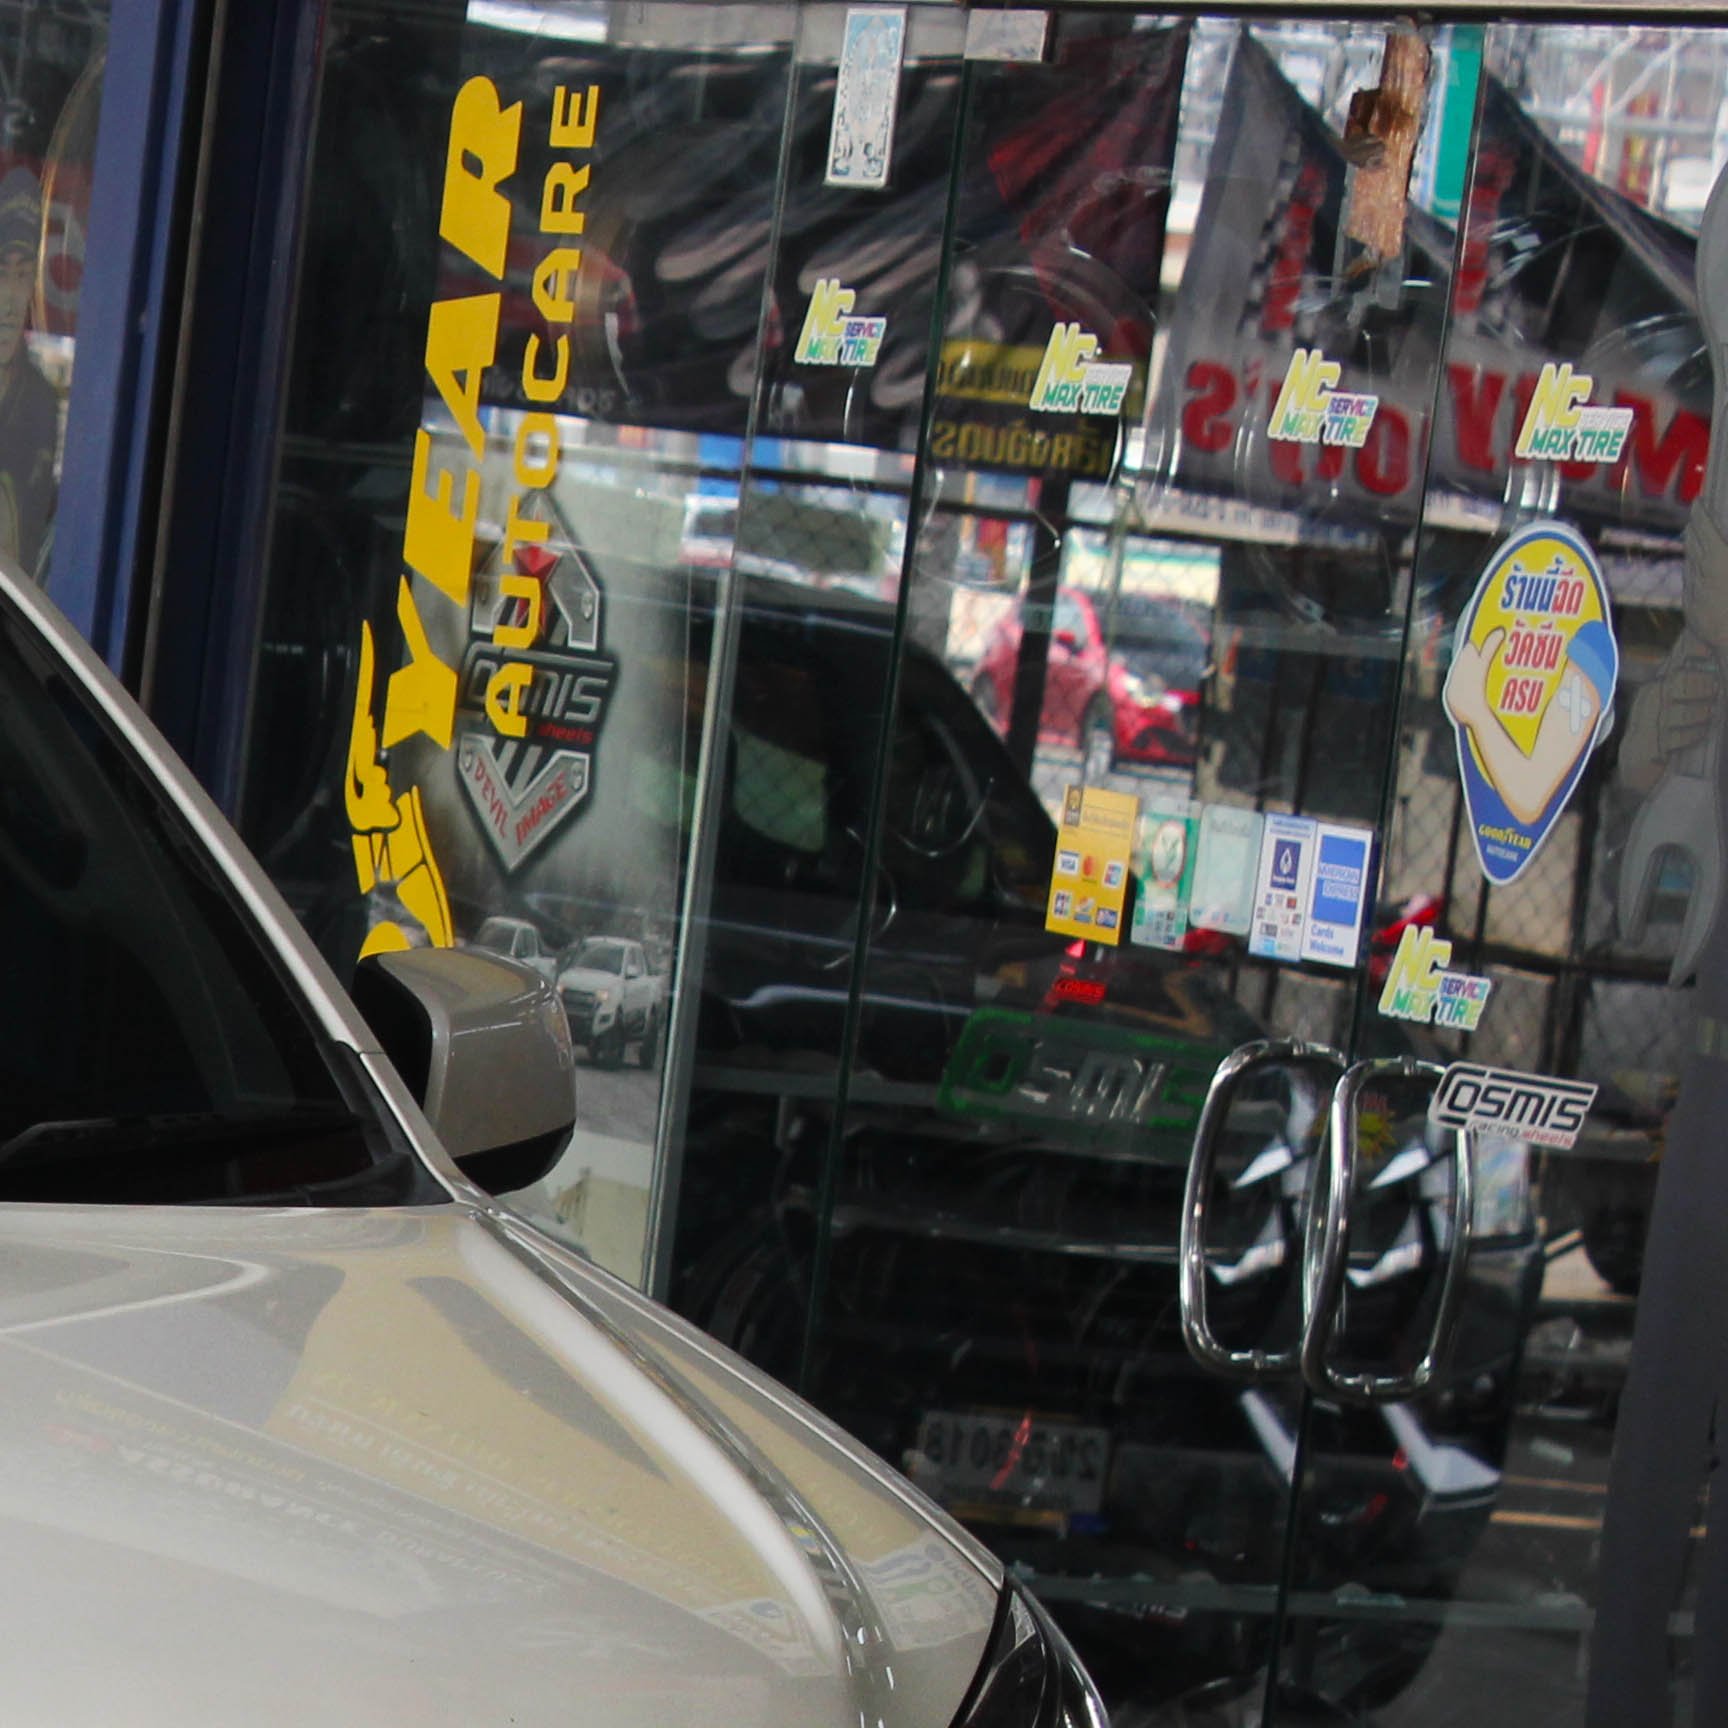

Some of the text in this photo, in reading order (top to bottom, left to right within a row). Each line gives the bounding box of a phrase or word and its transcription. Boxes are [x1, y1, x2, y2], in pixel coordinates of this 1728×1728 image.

[1041, 383, 1124, 409] MAX TIRE
[1529, 428, 1625, 457] MAX TIRE
